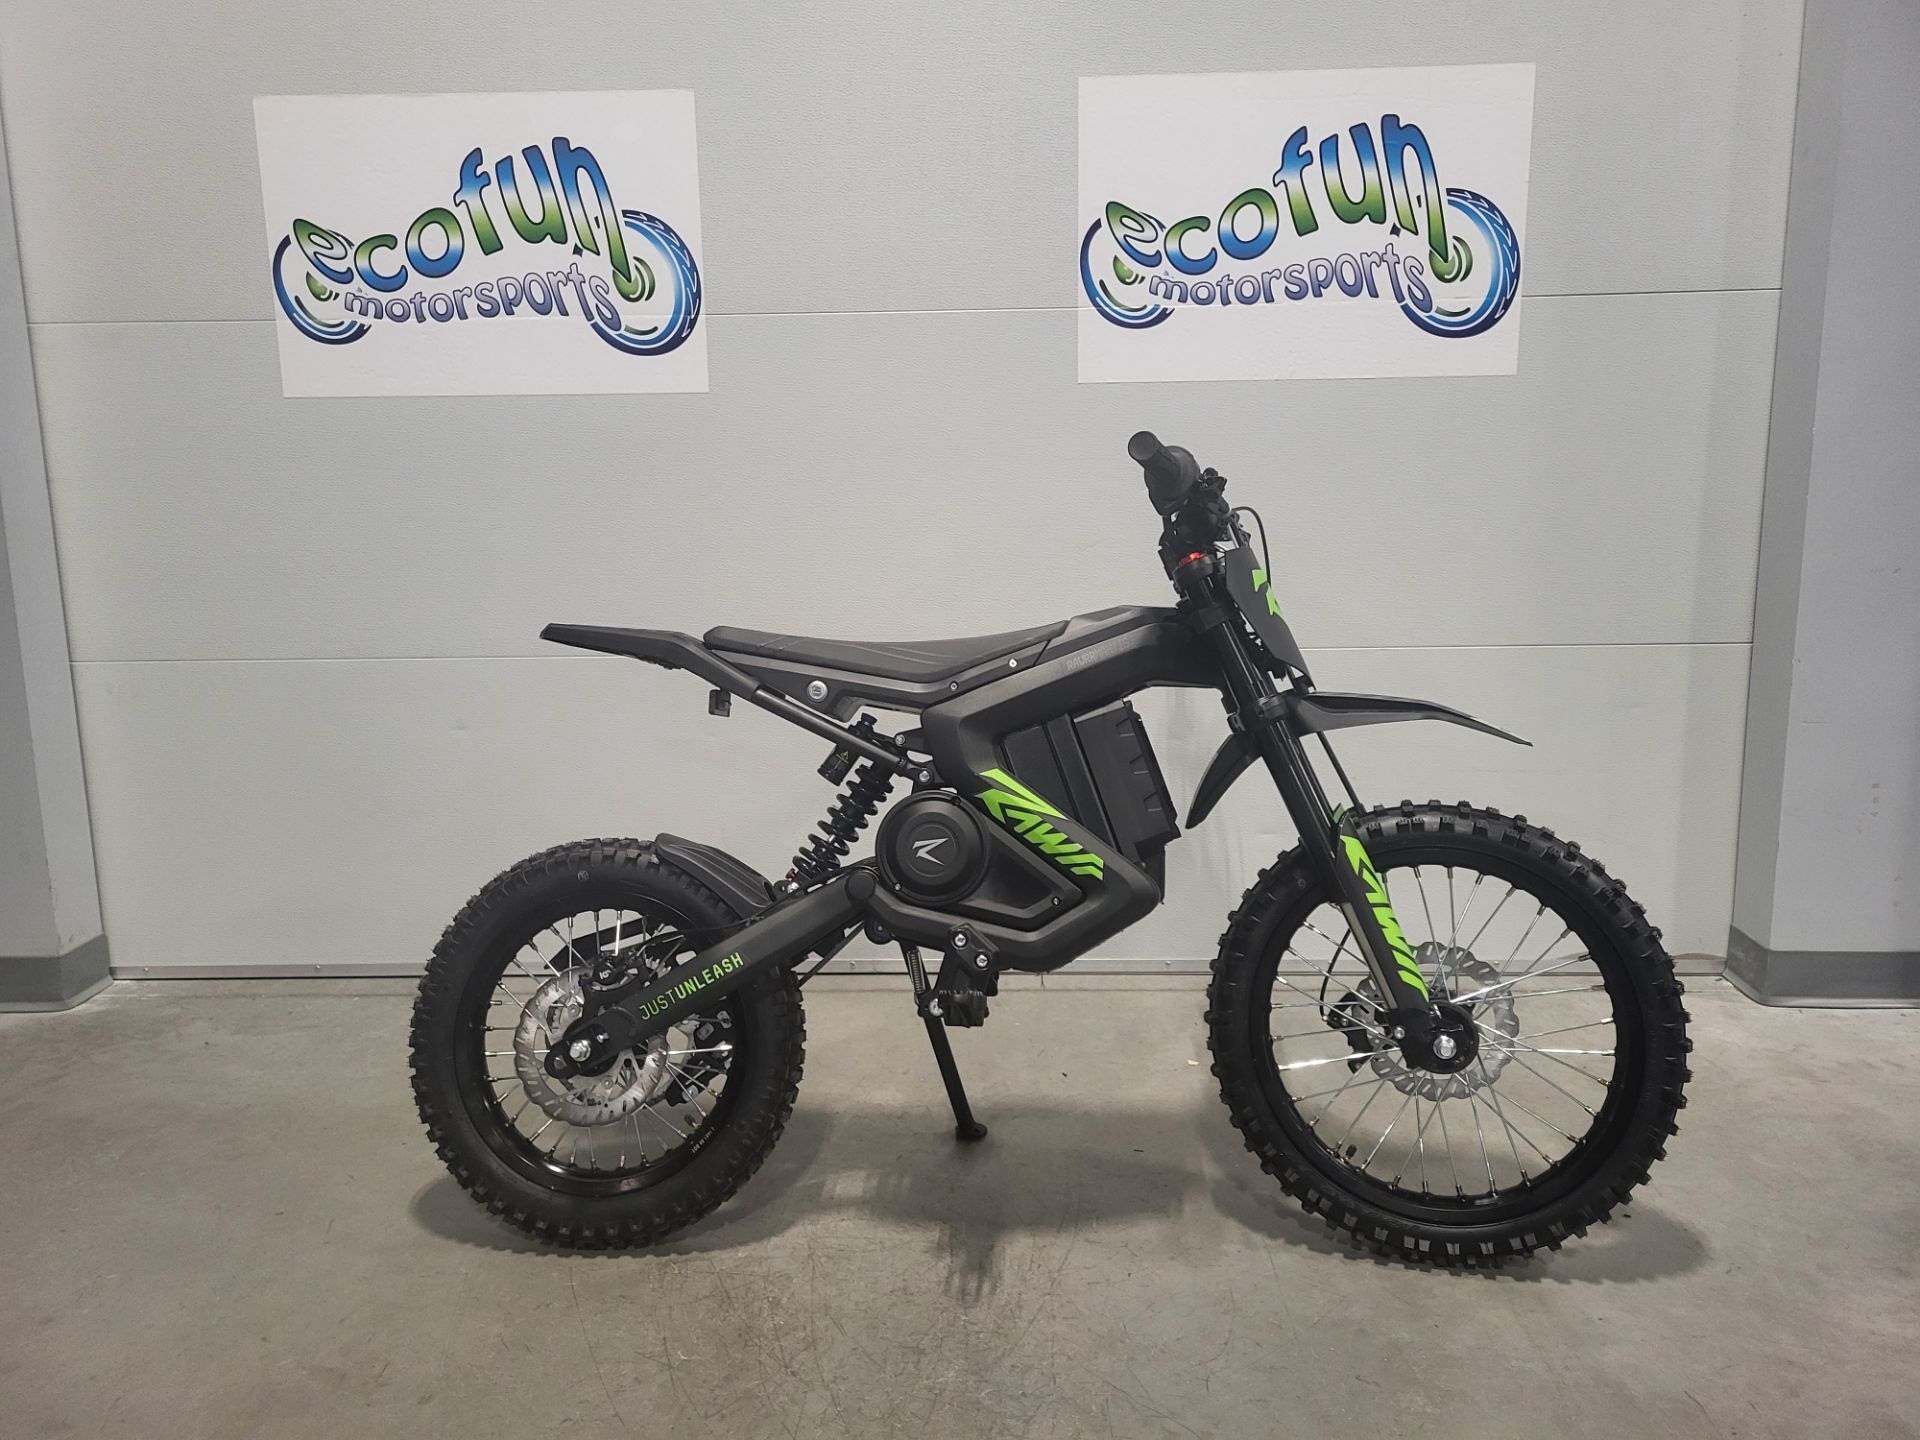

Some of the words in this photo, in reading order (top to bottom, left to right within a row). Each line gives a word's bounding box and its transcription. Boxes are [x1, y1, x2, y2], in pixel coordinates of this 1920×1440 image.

[293, 136, 633, 285] ecofun
[1106, 113, 1449, 268] ecofun
[344, 262, 623, 333] motorsports
[1149, 243, 1434, 314] motorsports
